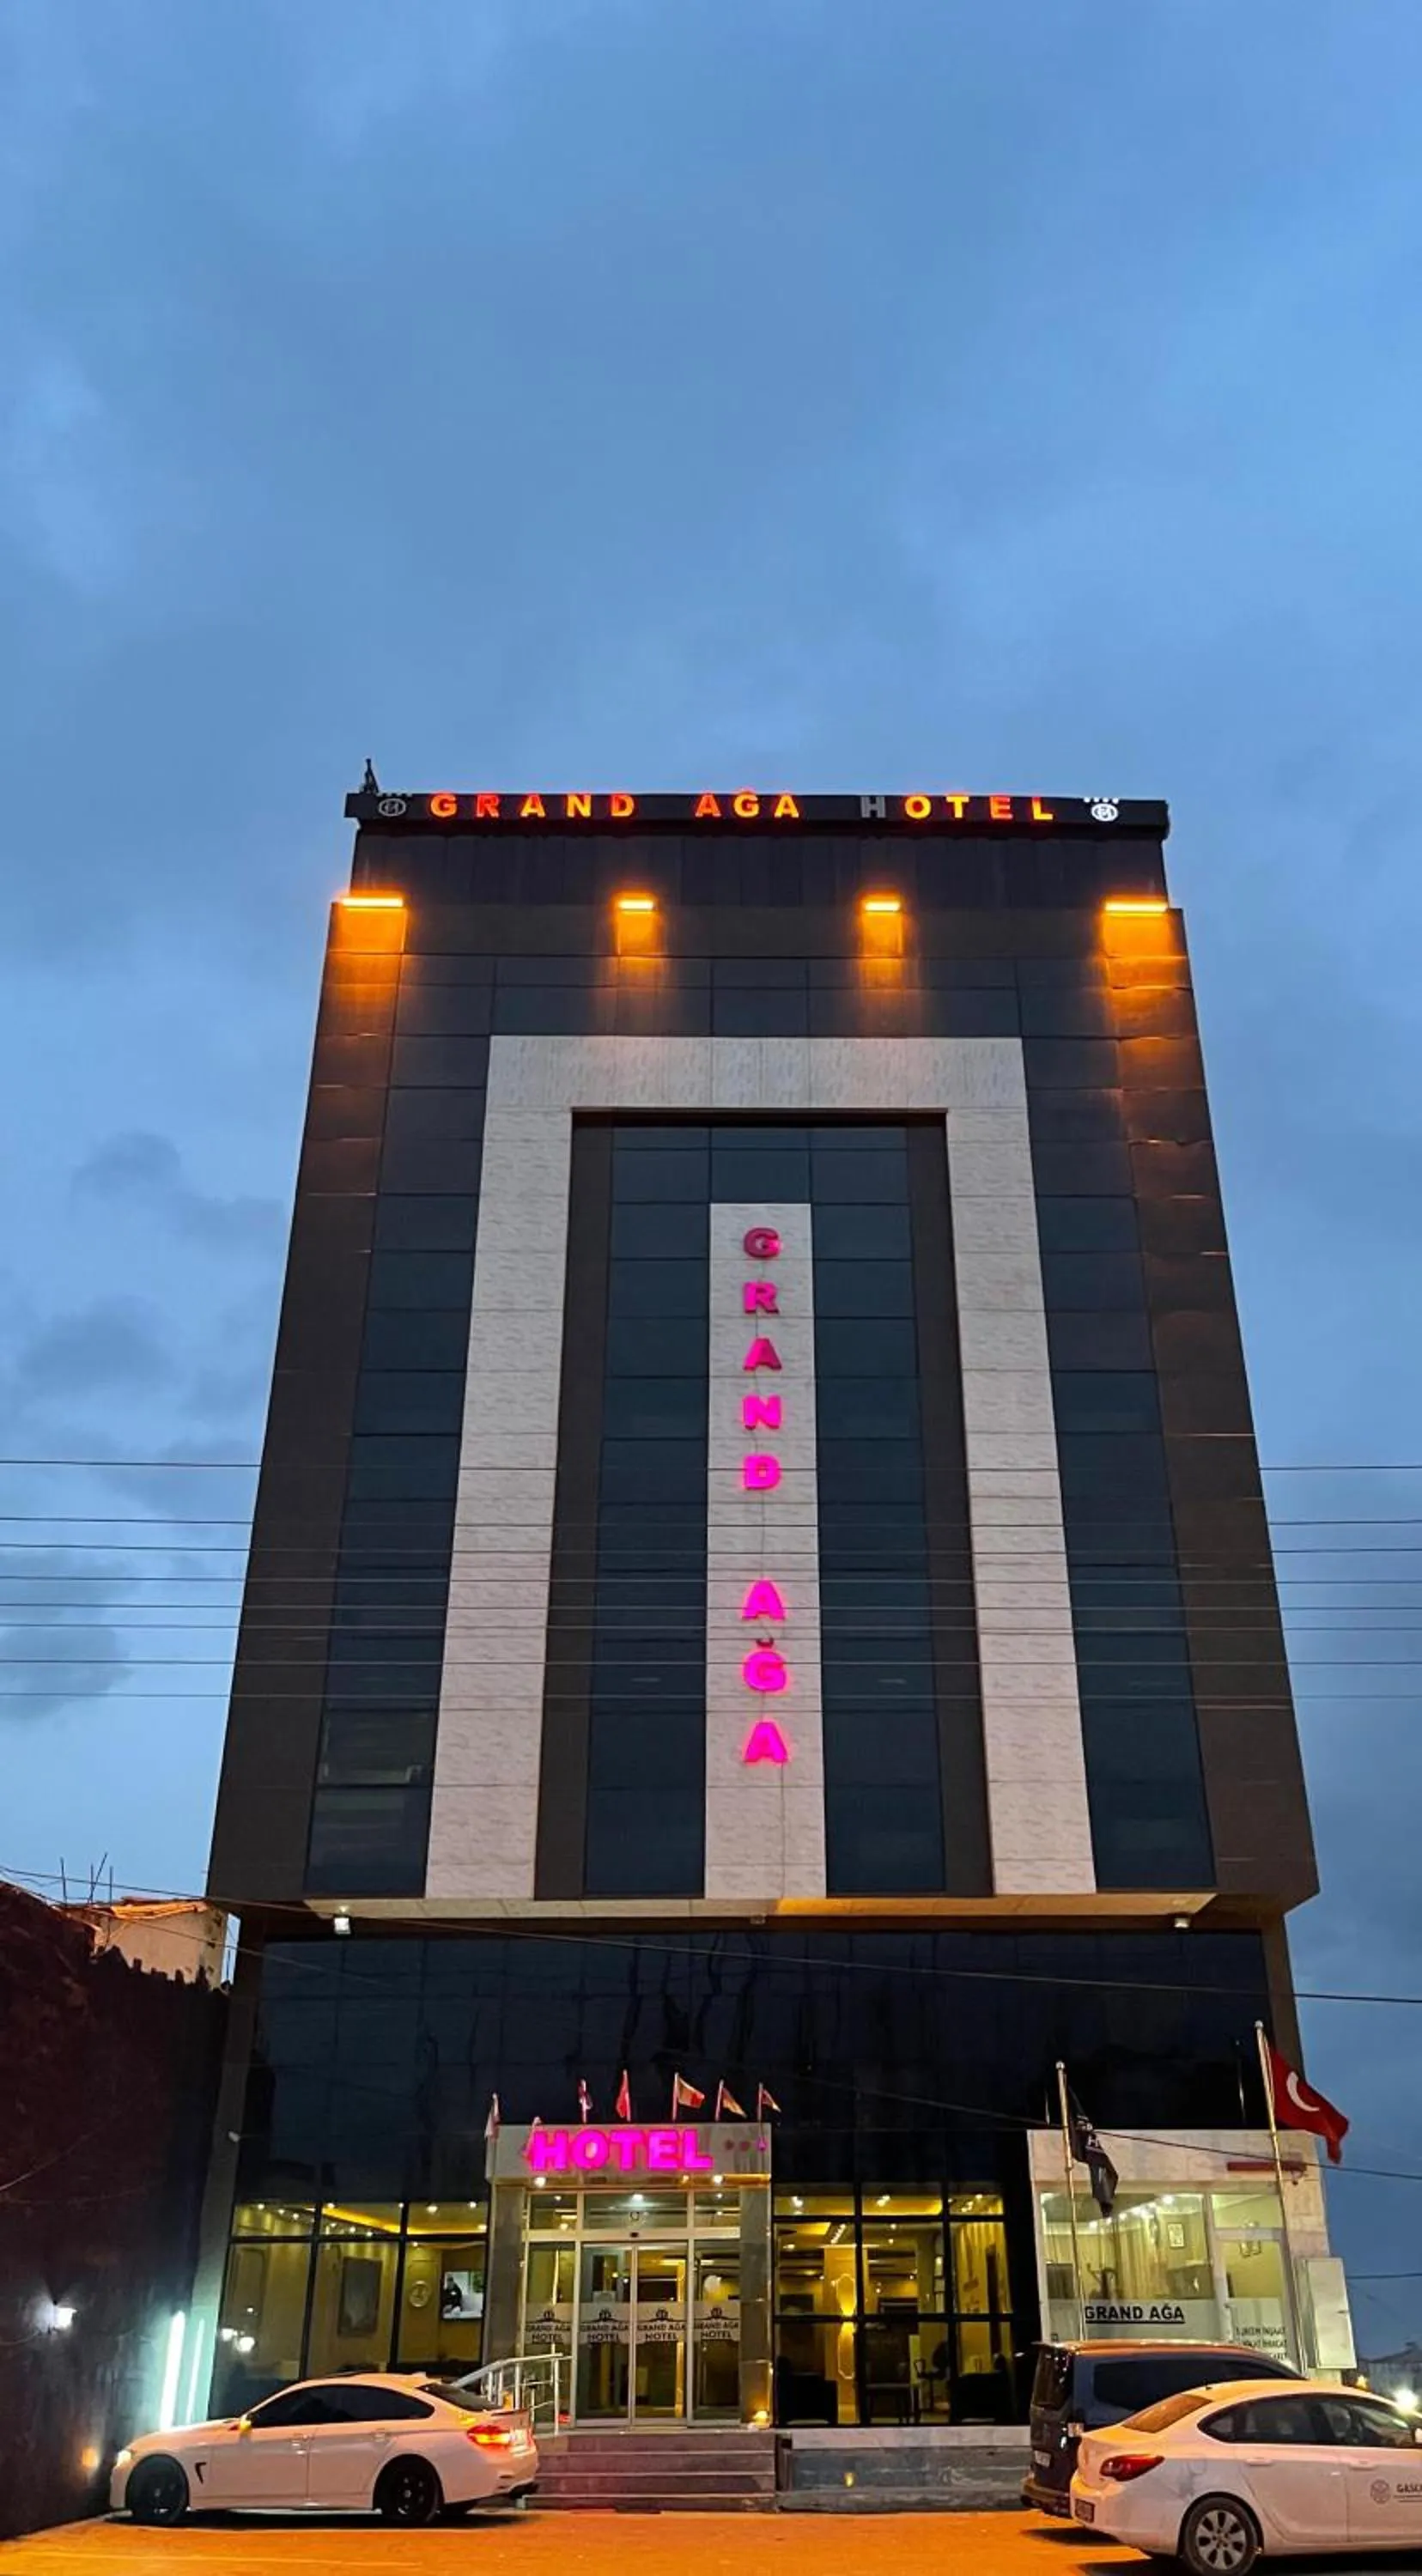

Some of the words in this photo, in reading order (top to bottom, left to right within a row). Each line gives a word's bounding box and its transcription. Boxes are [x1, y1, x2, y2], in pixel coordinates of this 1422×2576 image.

[430, 793, 635, 818] GRAND
[860, 795, 1054, 821] HOTEL
[742, 1227, 783, 1492] GRAND
[741, 1578, 790, 1763] AĞA
[530, 2129, 714, 2172] HOTEL
[1085, 2306, 1144, 2320] GRAND
[1150, 2303, 1184, 2320] AĞA
[645, 2332, 678, 2342] HOTEL
[701, 2330, 732, 2340] HOTEL
